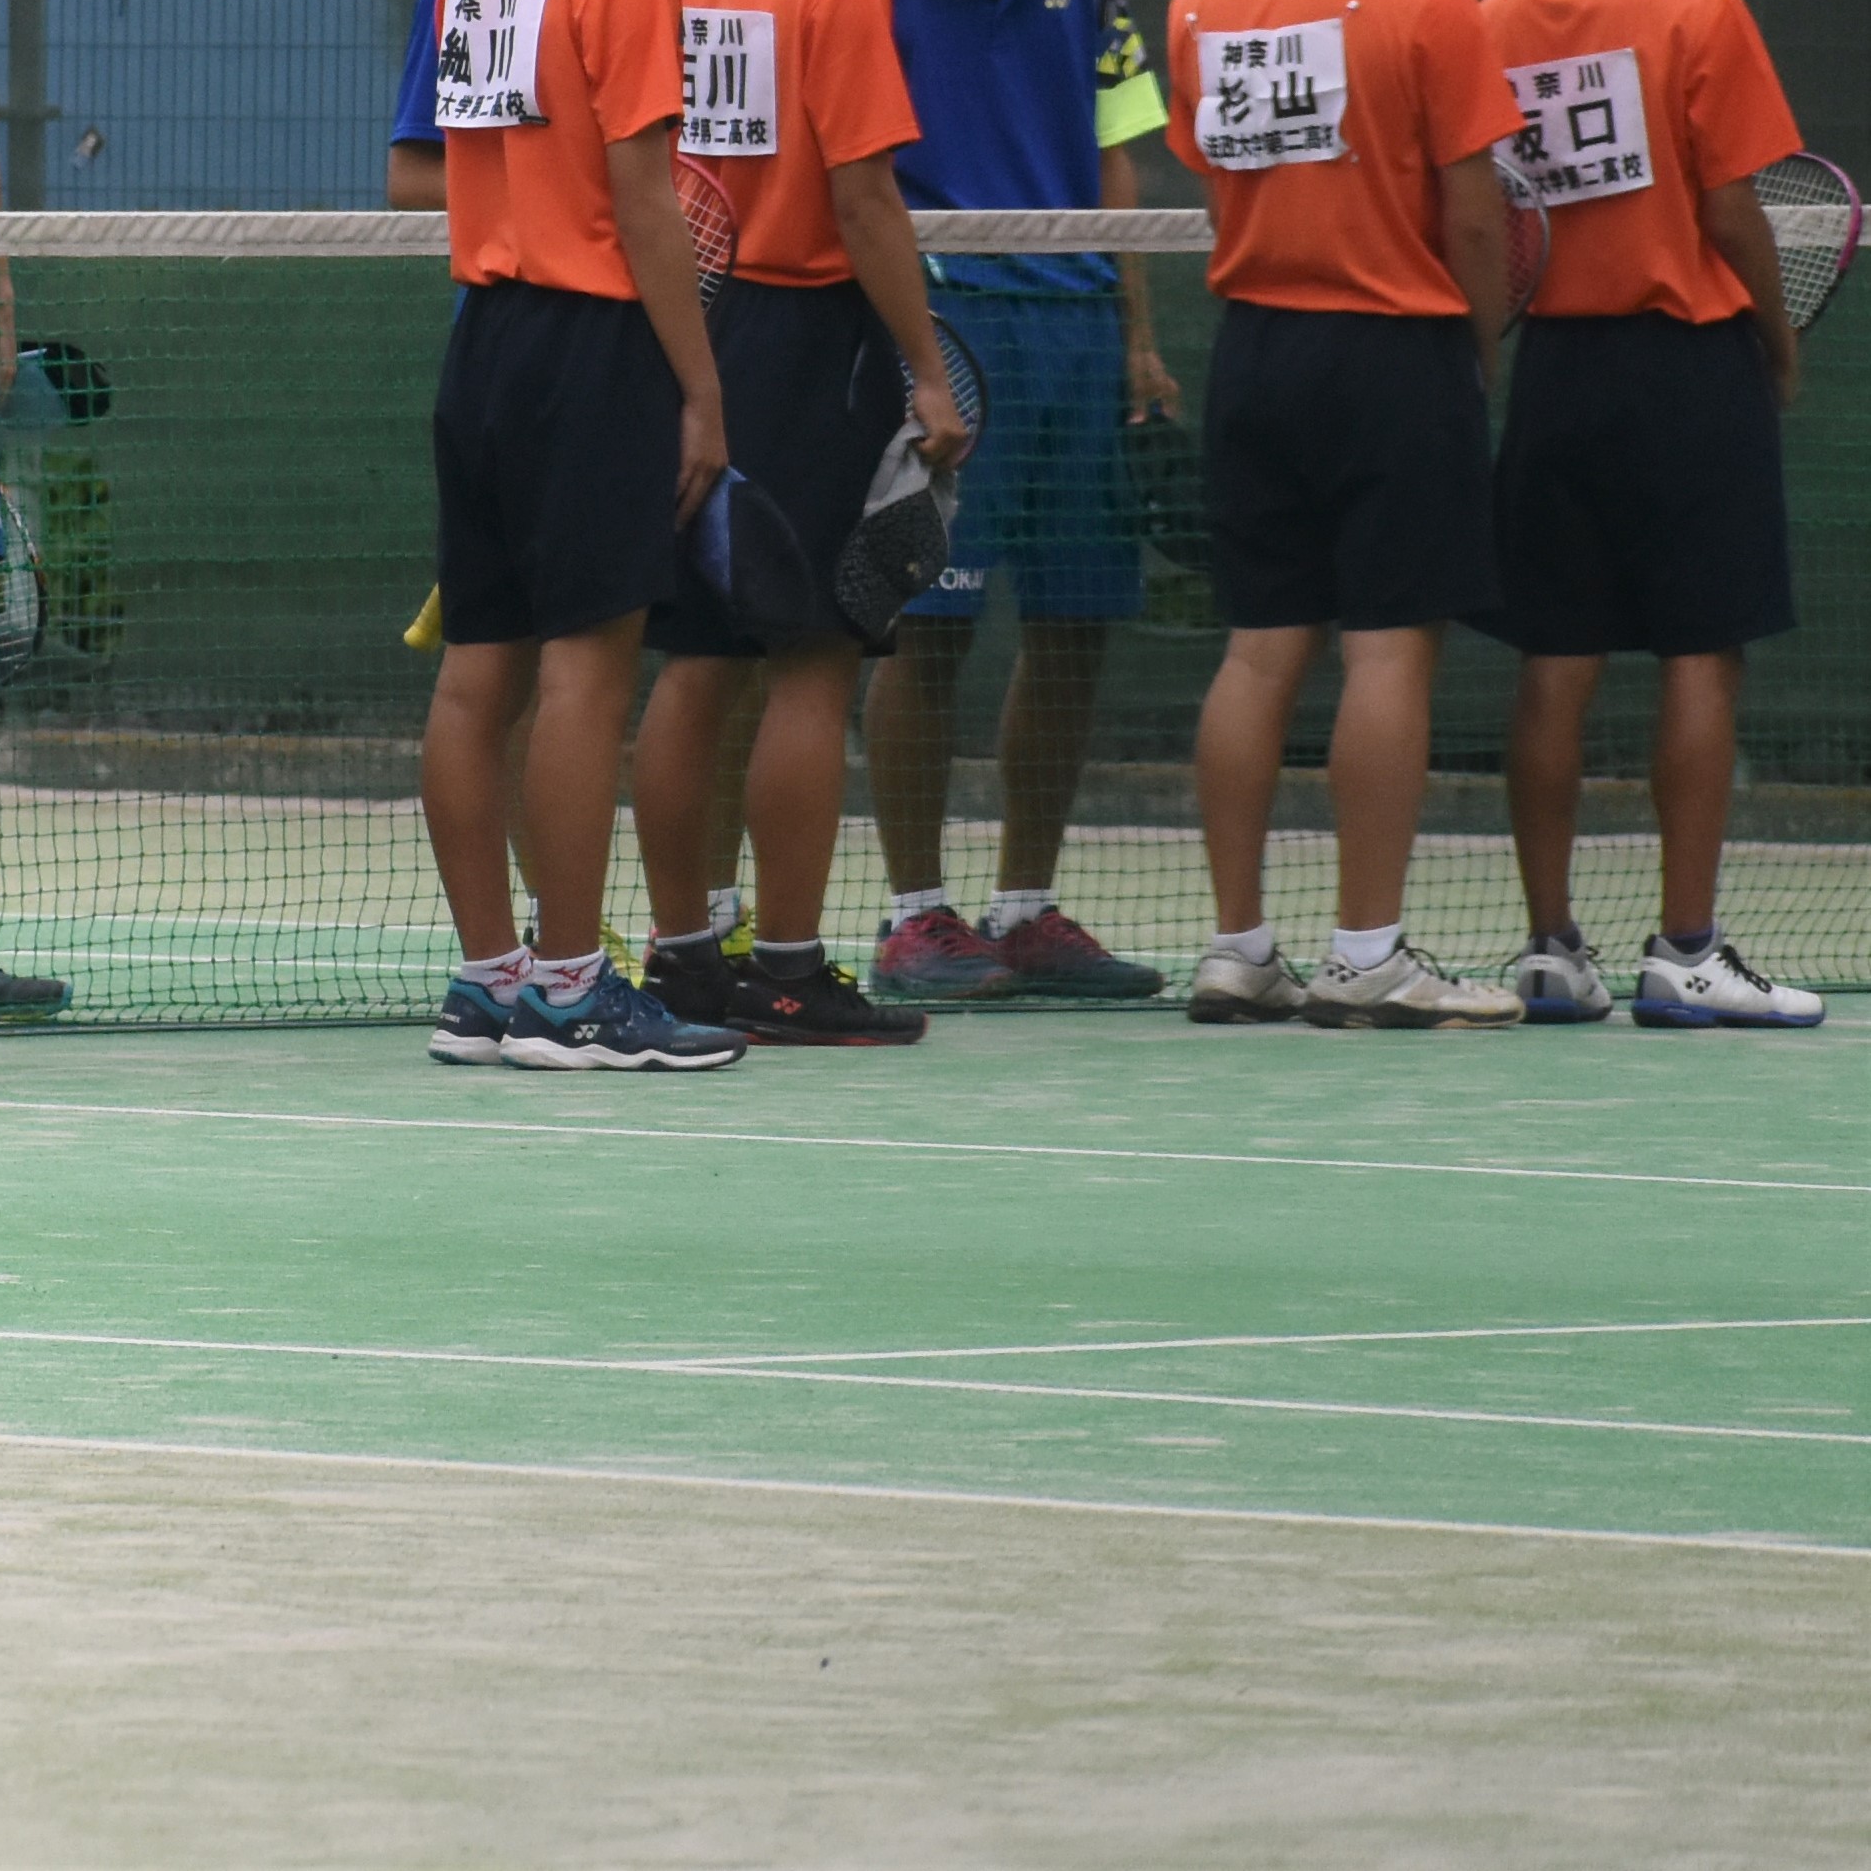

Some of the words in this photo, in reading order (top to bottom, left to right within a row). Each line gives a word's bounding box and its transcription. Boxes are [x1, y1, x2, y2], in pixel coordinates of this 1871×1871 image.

[680, 18, 743, 46] 奈川
[1221, 34, 1303, 71] 神奈川
[1510, 61, 1605, 99] 奈川
[436, 89, 527, 120] 大学第二高校
[1216, 71, 1318, 127] 杉山
